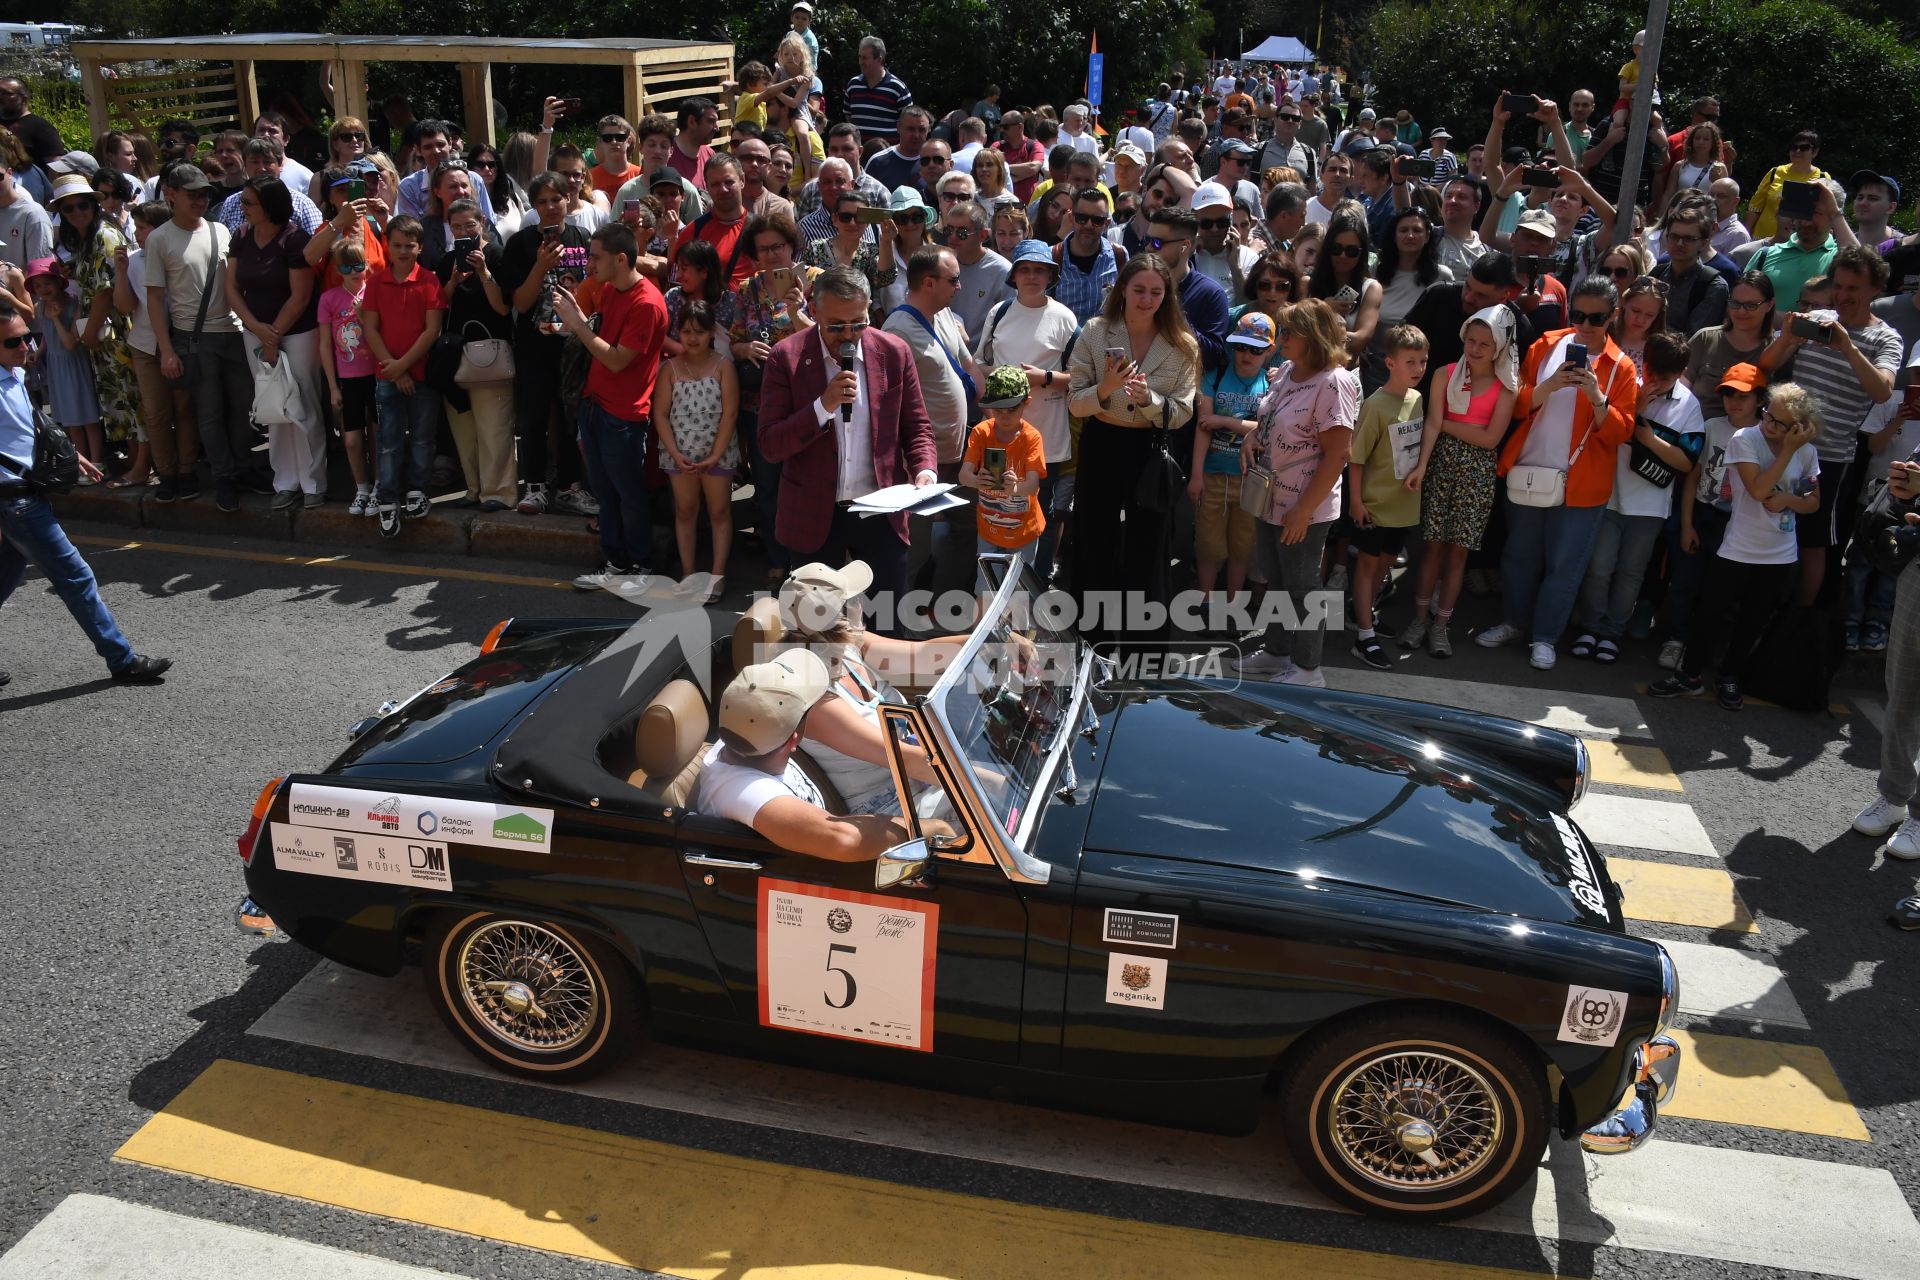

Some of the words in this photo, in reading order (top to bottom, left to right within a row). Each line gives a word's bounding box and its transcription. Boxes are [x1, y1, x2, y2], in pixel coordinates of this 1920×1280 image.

[1398, 424, 1413, 435] REAL
[441, 816, 472, 827] баланс
[441, 826, 474, 836] информ
[495, 829, 528, 840] Ферма
[530, 833, 543, 841] 56
[408, 845, 445, 871] DM
[367, 861, 401, 873] RODIS
[1137, 920, 1171, 929] СТРАХОВАЯ
[1136, 930, 1171, 938] КОМПАНИЯ
[824, 943, 857, 1009] 5
